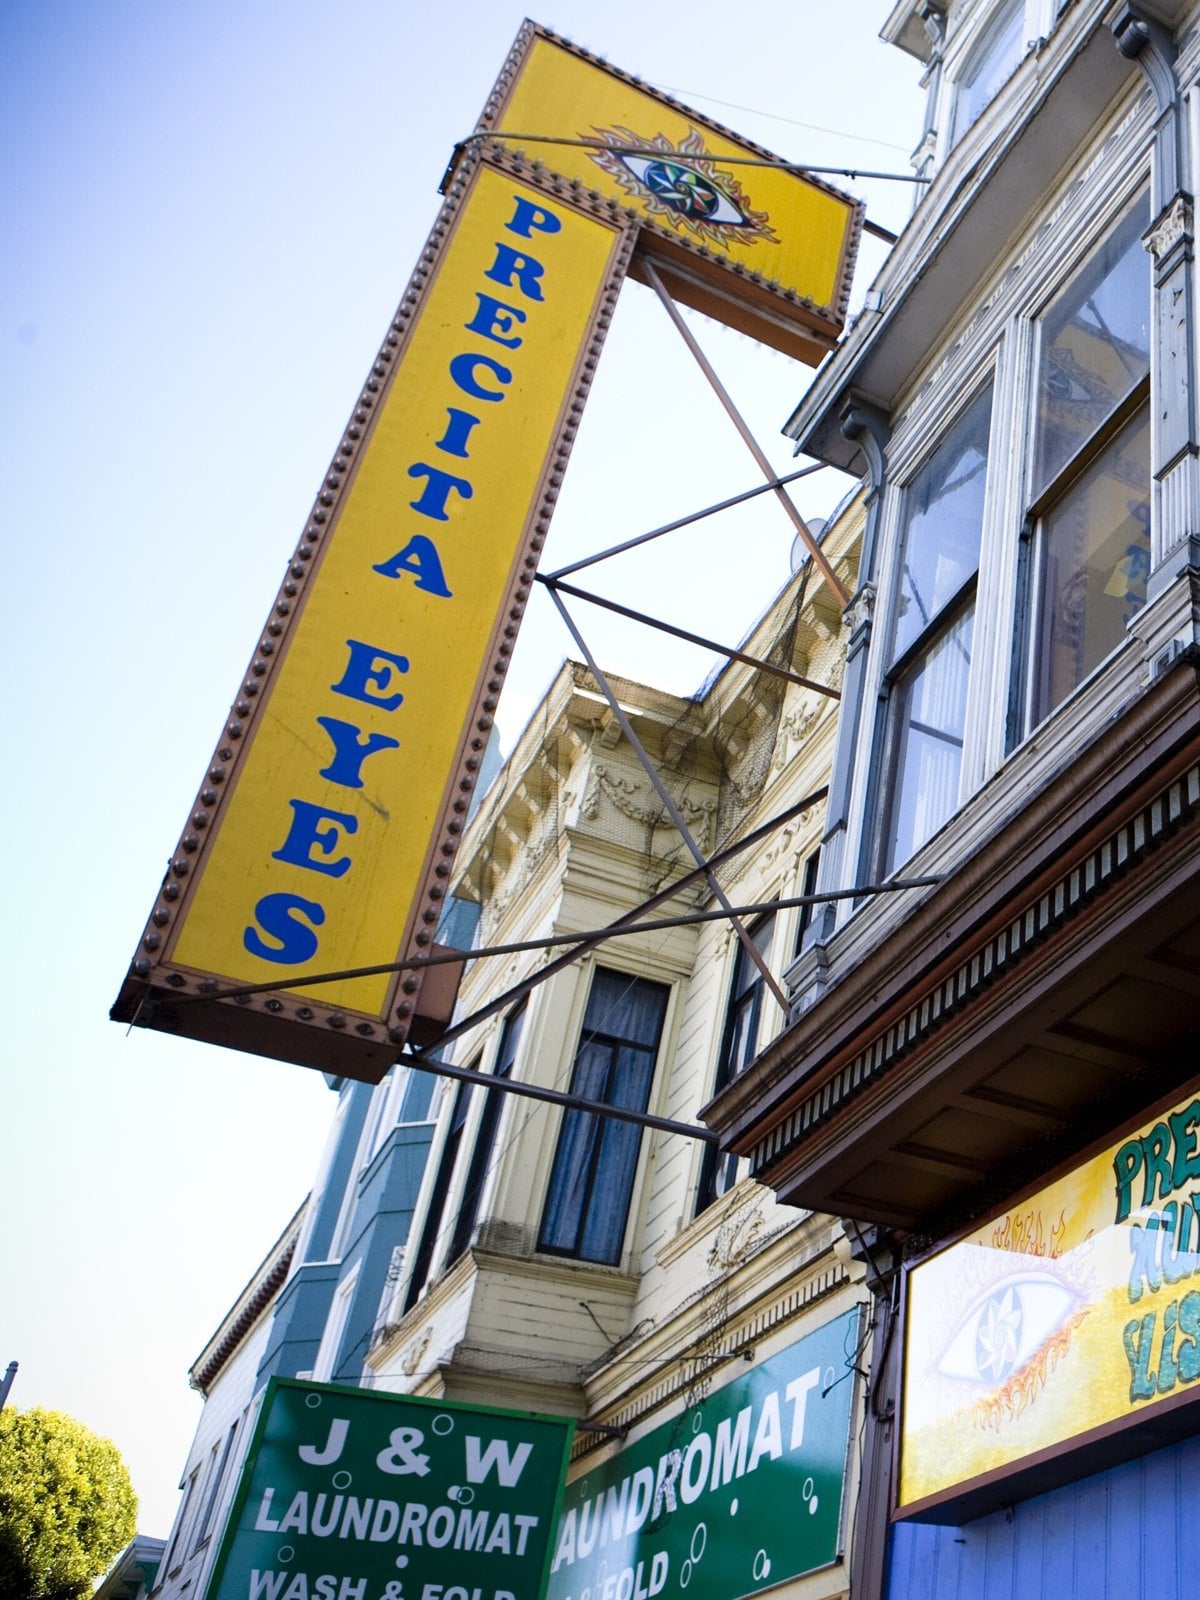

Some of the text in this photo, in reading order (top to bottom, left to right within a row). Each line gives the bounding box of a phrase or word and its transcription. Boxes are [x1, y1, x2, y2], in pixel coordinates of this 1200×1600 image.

[243, 195, 562, 965] PRECITA EYES
[298, 1418, 534, 1488] J & W
[550, 1367, 822, 1575] AUNDROMAT
[254, 1487, 538, 1556] LAUNDROMAT
[249, 1568, 368, 1600] WASH
[379, 1580, 405, 1600] &
